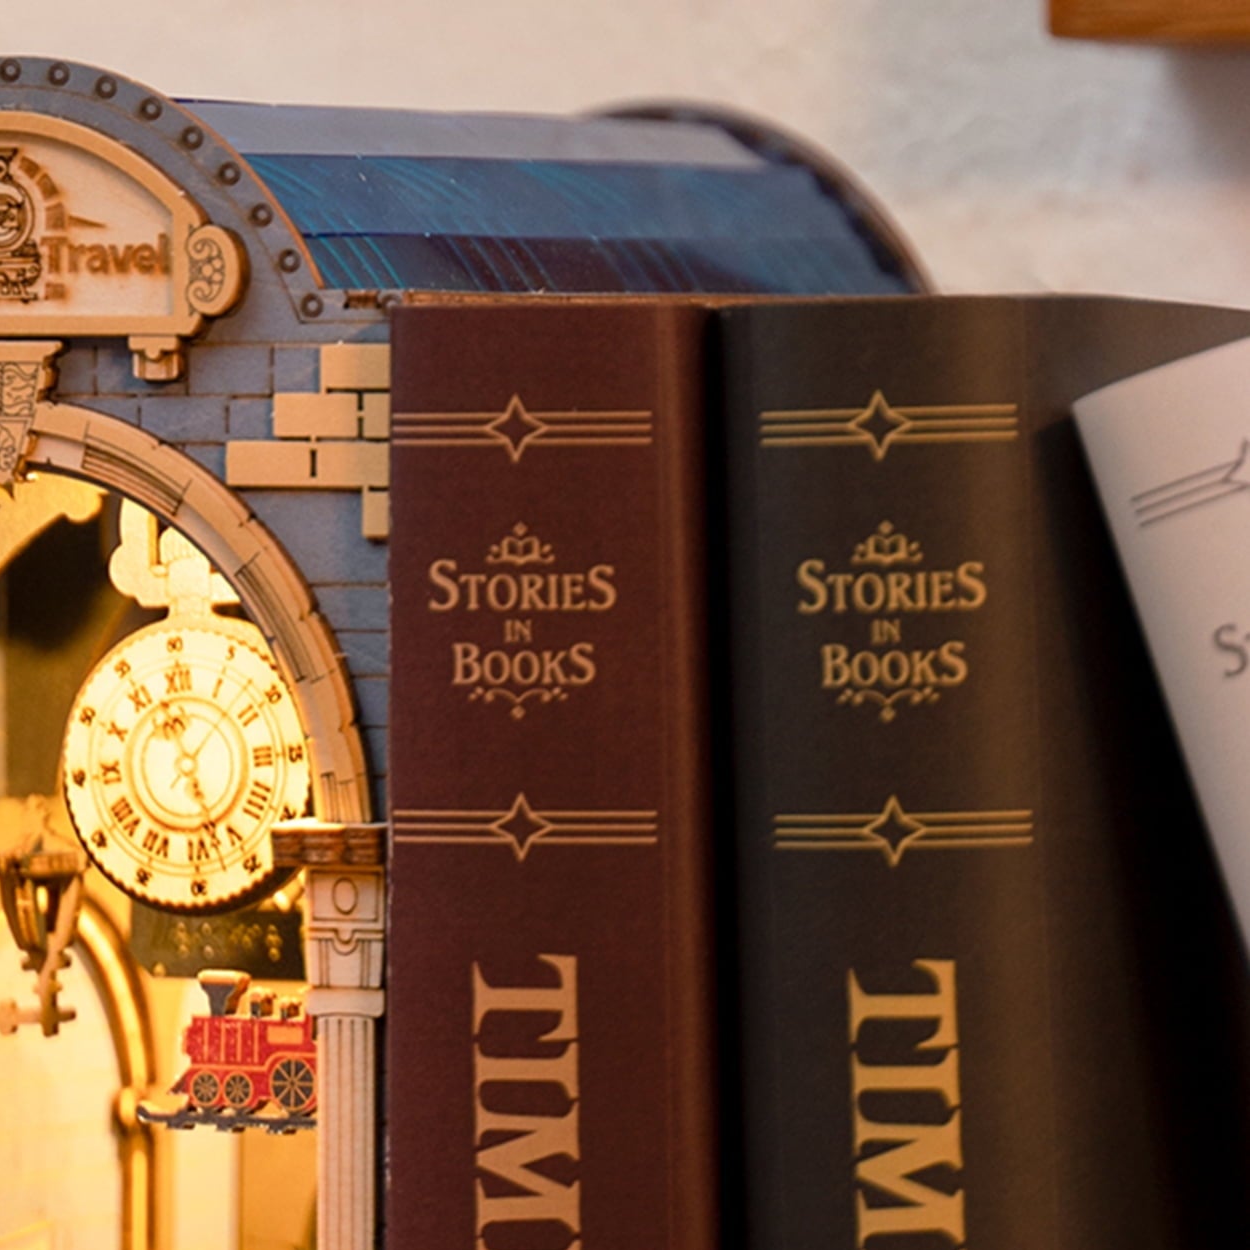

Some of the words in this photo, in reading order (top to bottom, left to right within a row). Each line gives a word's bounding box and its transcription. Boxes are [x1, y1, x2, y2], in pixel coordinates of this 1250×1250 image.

[41, 234, 168, 277] Travel
[428, 559, 617, 612] STORIES
[797, 560, 988, 616] STORIES
[504, 619, 533, 644] IN
[871, 619, 902, 645] IN
[452, 642, 597, 685] BOOKS
[821, 641, 969, 689] BOOKS
